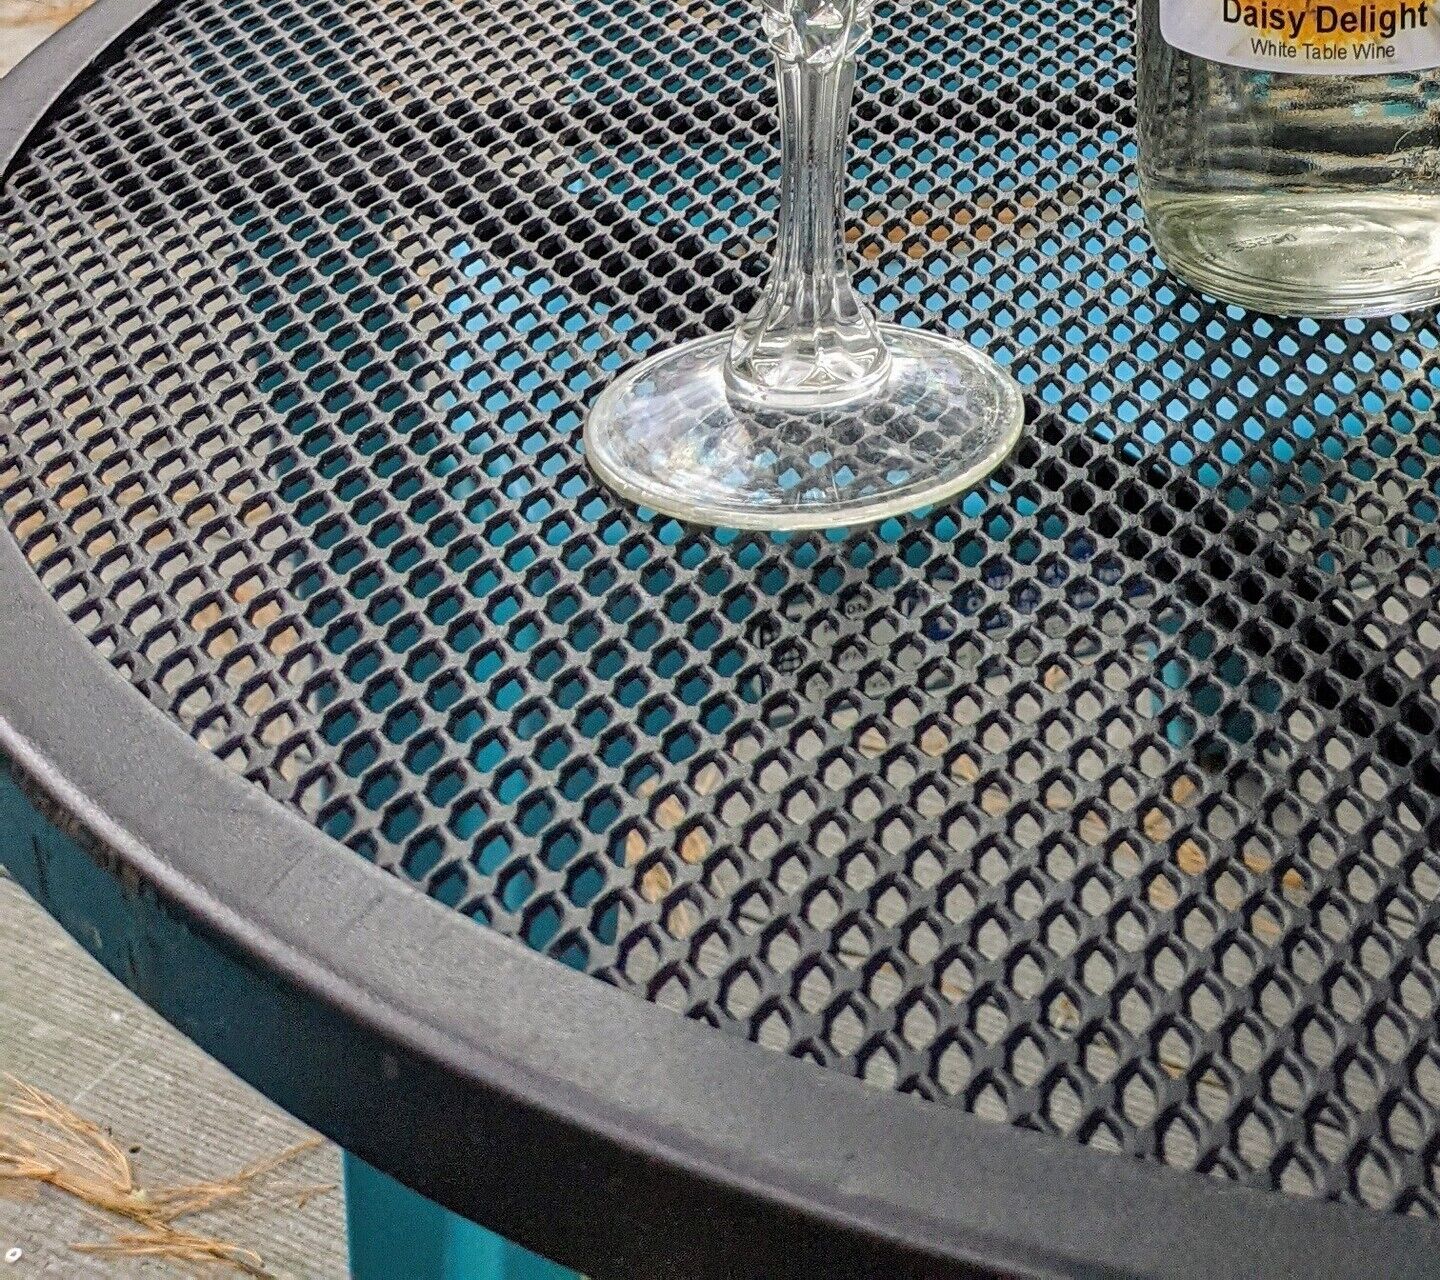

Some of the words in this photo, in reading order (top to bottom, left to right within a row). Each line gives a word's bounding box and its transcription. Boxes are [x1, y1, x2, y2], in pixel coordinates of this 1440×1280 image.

[1315, 0, 1429, 38] Delight
[1250, 37, 1298, 60] White
[1301, 43, 1348, 60] Table
[1352, 42, 1396, 60] Wine
